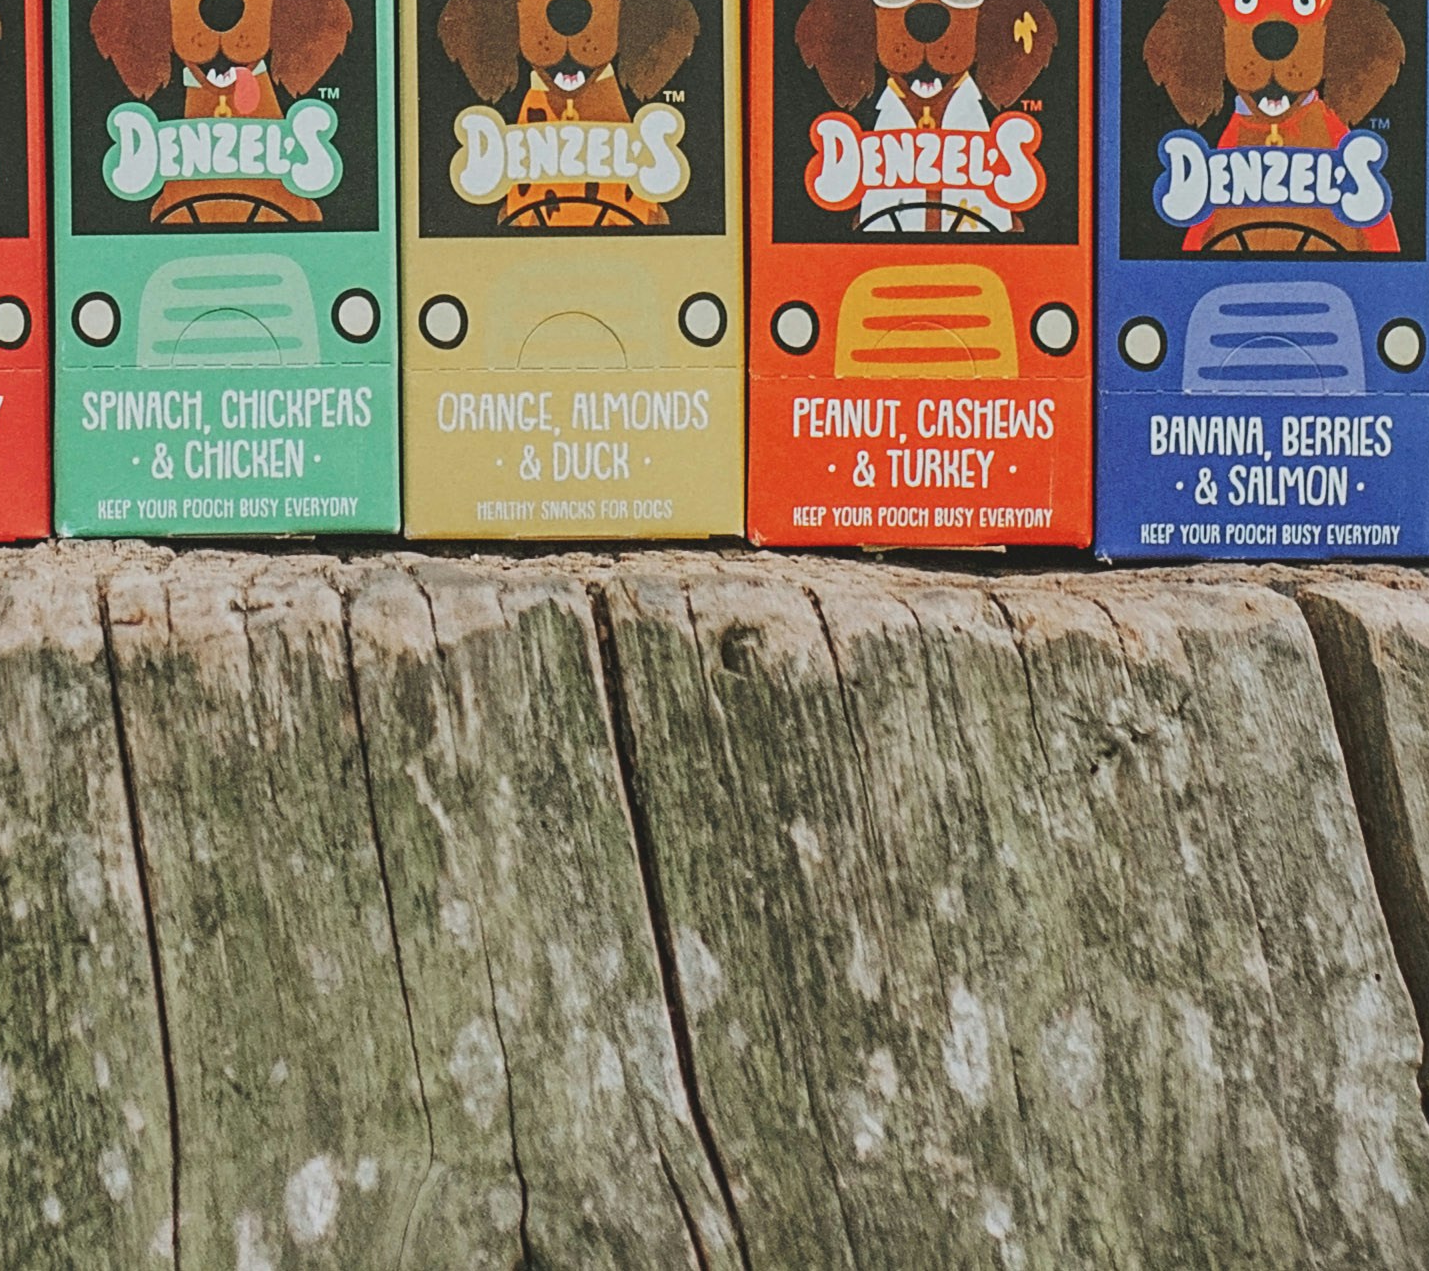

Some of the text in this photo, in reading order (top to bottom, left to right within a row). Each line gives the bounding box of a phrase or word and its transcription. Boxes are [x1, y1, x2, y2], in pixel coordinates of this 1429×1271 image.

[318, 87, 340, 99] TM
[662, 90, 685, 102] TM
[1021, 100, 1043, 112] TM
[1369, 118, 1391, 130] TM
[111, 106, 335, 194] DENZEL'S
[459, 109, 681, 196] DENZEL'S
[814, 117, 1038, 203] DENZEL'S
[1162, 135, 1384, 222] DENZEL'S
[81, 386, 373, 435] SPINACH, CHICKPEAS
[437, 389, 709, 436] ORANGE, ALMONDS
[793, 397, 1055, 444] PEANUT, CASHEWS
[151, 438, 304, 480] & CHICKEN
[1150, 415, 1393, 462] BANANA, BERRIES
[519, 441, 630, 481] & DUCK
[852, 448, 995, 489] & TURKEY
[1194, 464, 1348, 506] & SALMON
[98, 497, 359, 520] KEEP YOUR POOCH BUSY EVERYDAY
[476, 499, 673, 521] HEALTHY SNACKS FOR DOGS
[793, 506, 1054, 528] KEEP YOUR POOCH BUSY EVERYDAY
[1140, 524, 1401, 546] KEEP YOUR POOCH BUSY EVERYDAY
